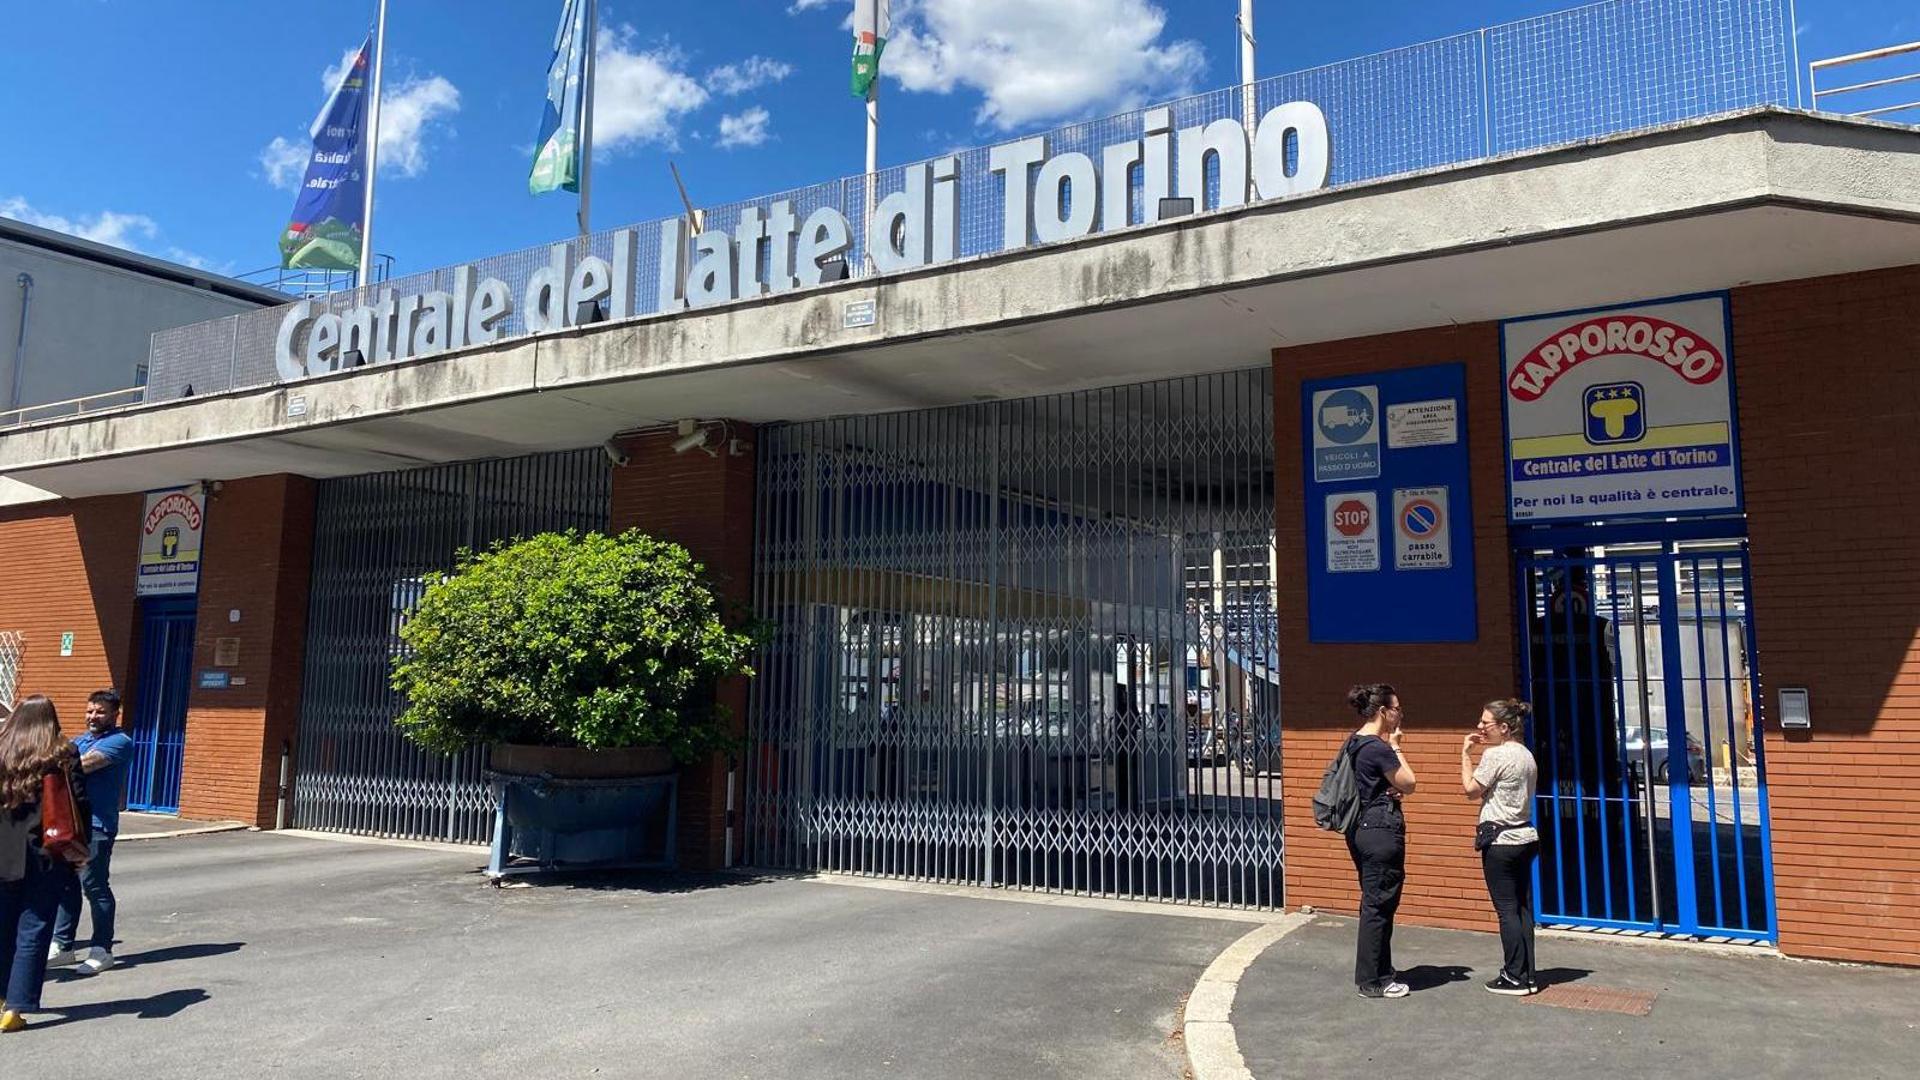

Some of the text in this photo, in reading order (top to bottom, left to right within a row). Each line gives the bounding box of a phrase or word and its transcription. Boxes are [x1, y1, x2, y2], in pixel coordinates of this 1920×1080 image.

[276, 101, 1330, 381] Centrale del Latte di Torino
[1511, 321, 1715, 395] TAPPOROSSO
[1407, 405, 1452, 415] ATTENZIONE
[1324, 451, 1370, 462] VEICOLI A
[1523, 448, 1717, 476] Centrale del Latte di Torino
[1513, 485, 1734, 508] Per noi la qualità è centrale.
[146, 497, 201, 532] TAPPOROSSO
[1335, 510, 1370, 526] STOP
[1402, 551, 1442, 562] carrabile
[1408, 543, 1435, 551] passo
